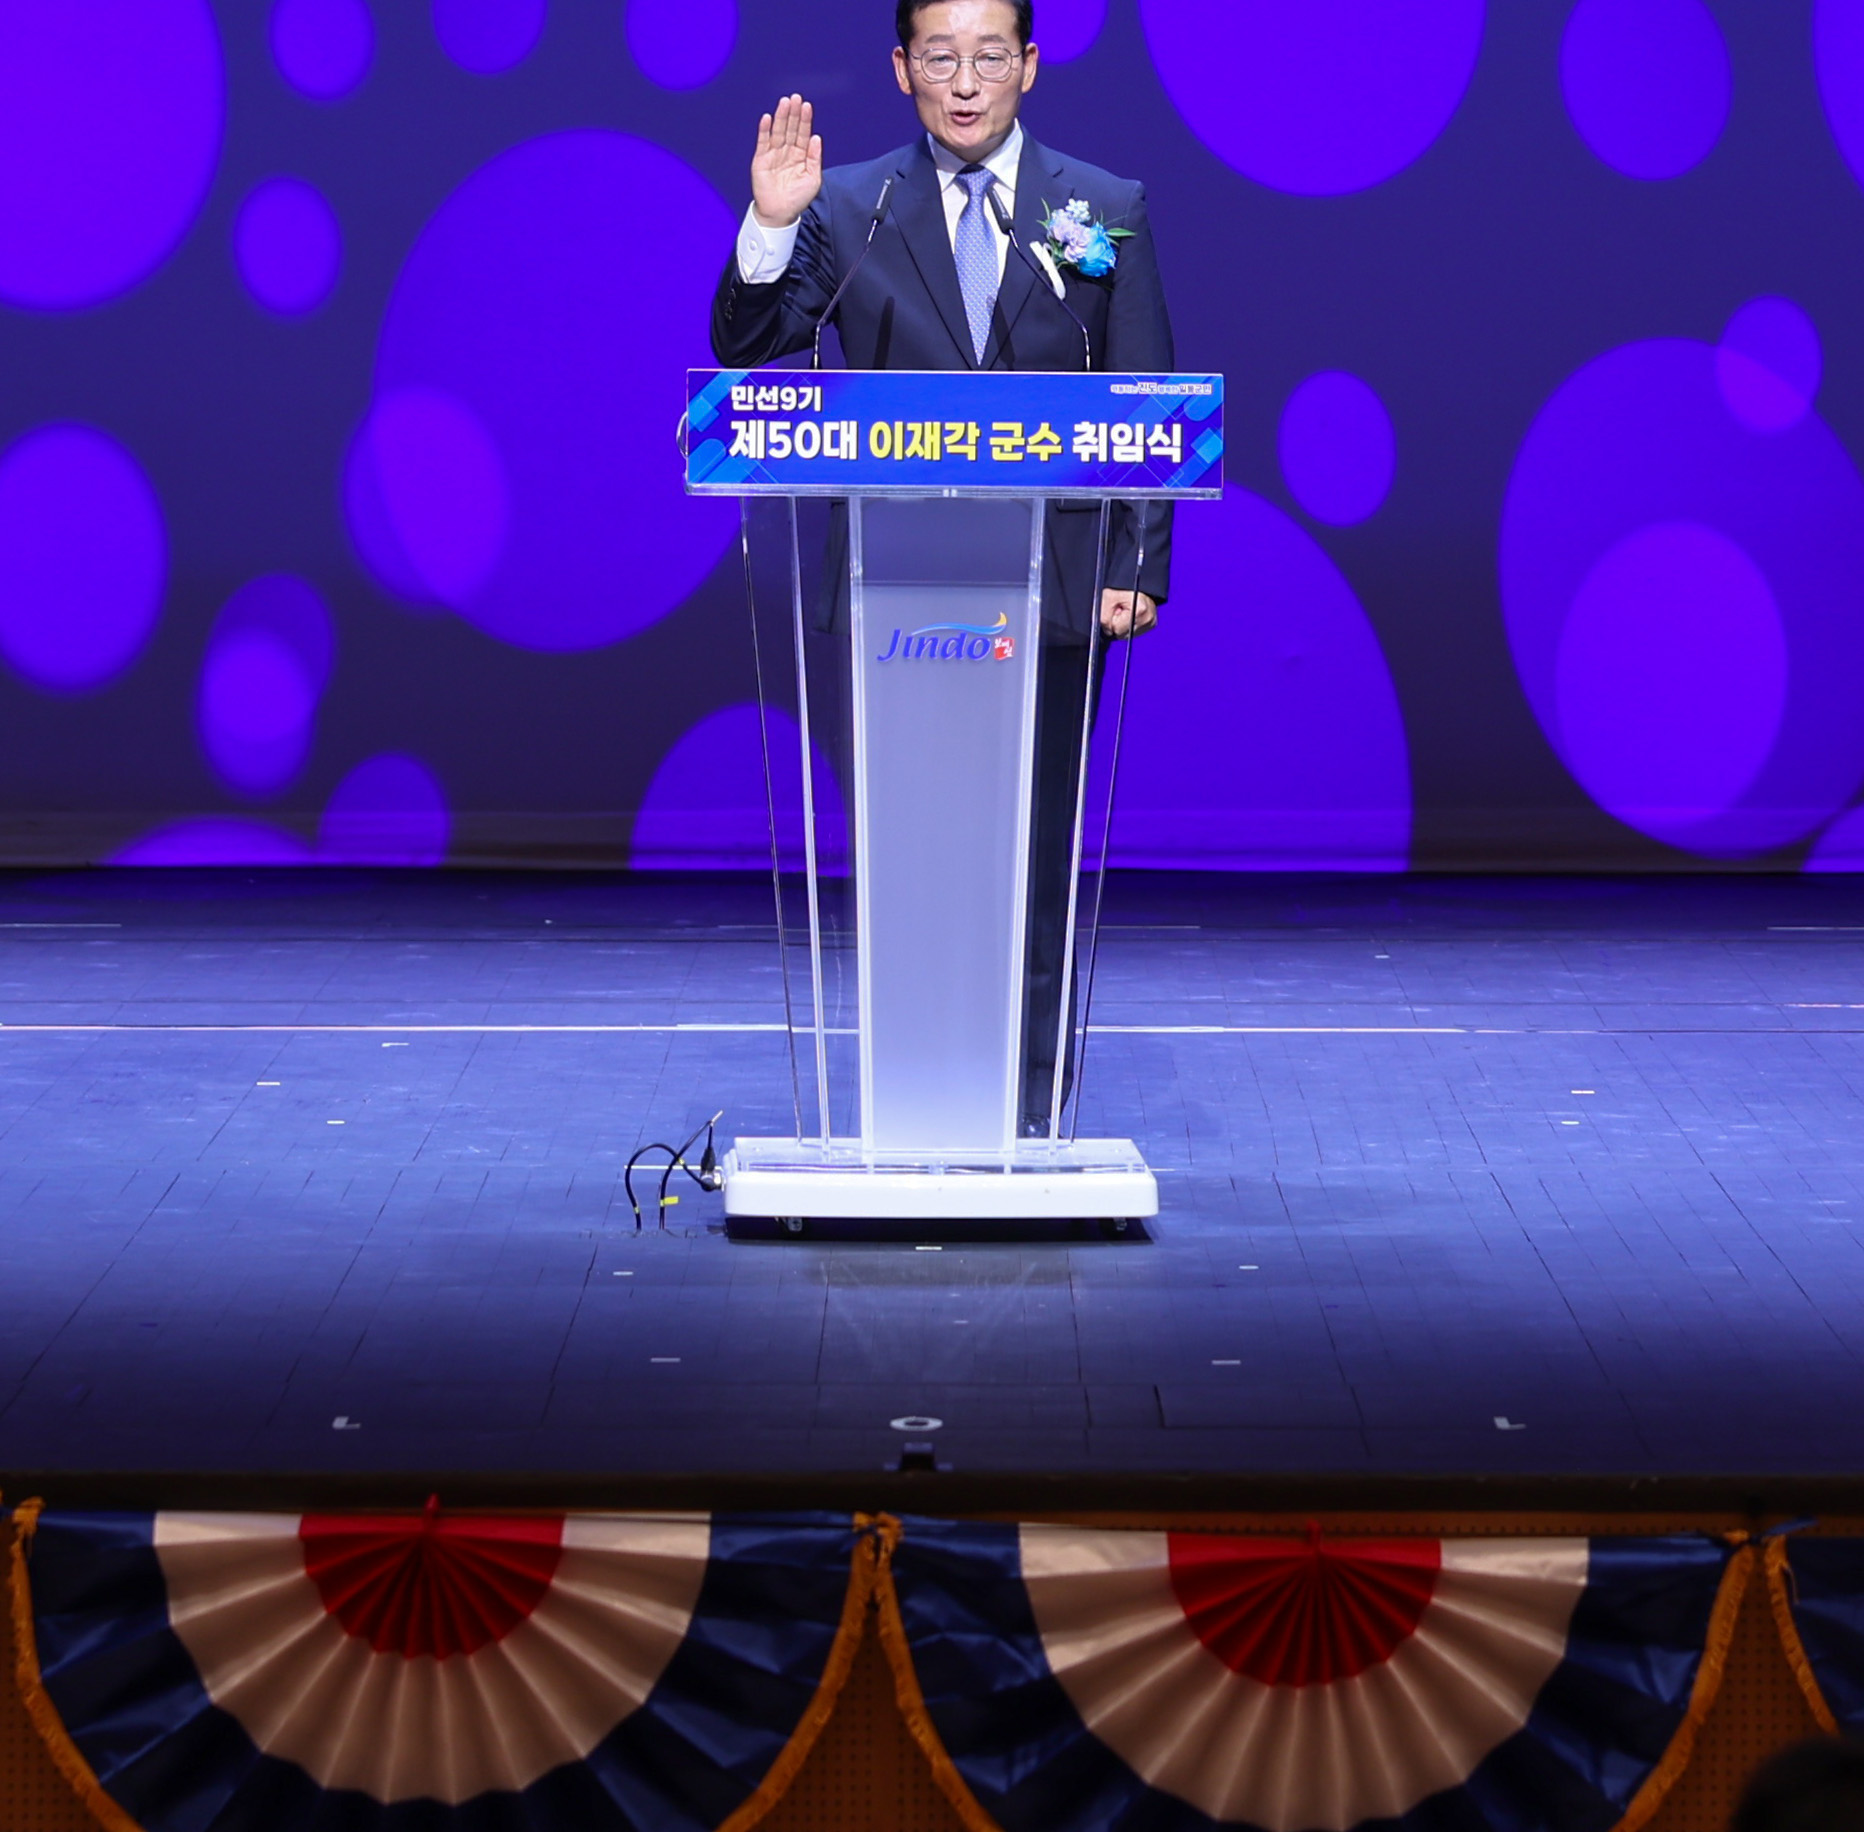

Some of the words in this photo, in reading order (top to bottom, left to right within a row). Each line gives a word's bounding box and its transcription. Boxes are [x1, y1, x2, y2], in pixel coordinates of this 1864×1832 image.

[730, 385, 822, 412] 민선9기
[729, 420, 858, 460] 제50대
[868, 420, 980, 461] 이재각
[989, 421, 1063, 462] 군수
[1072, 421, 1183, 463] 취임식
[877, 629, 991, 661] Jindo
